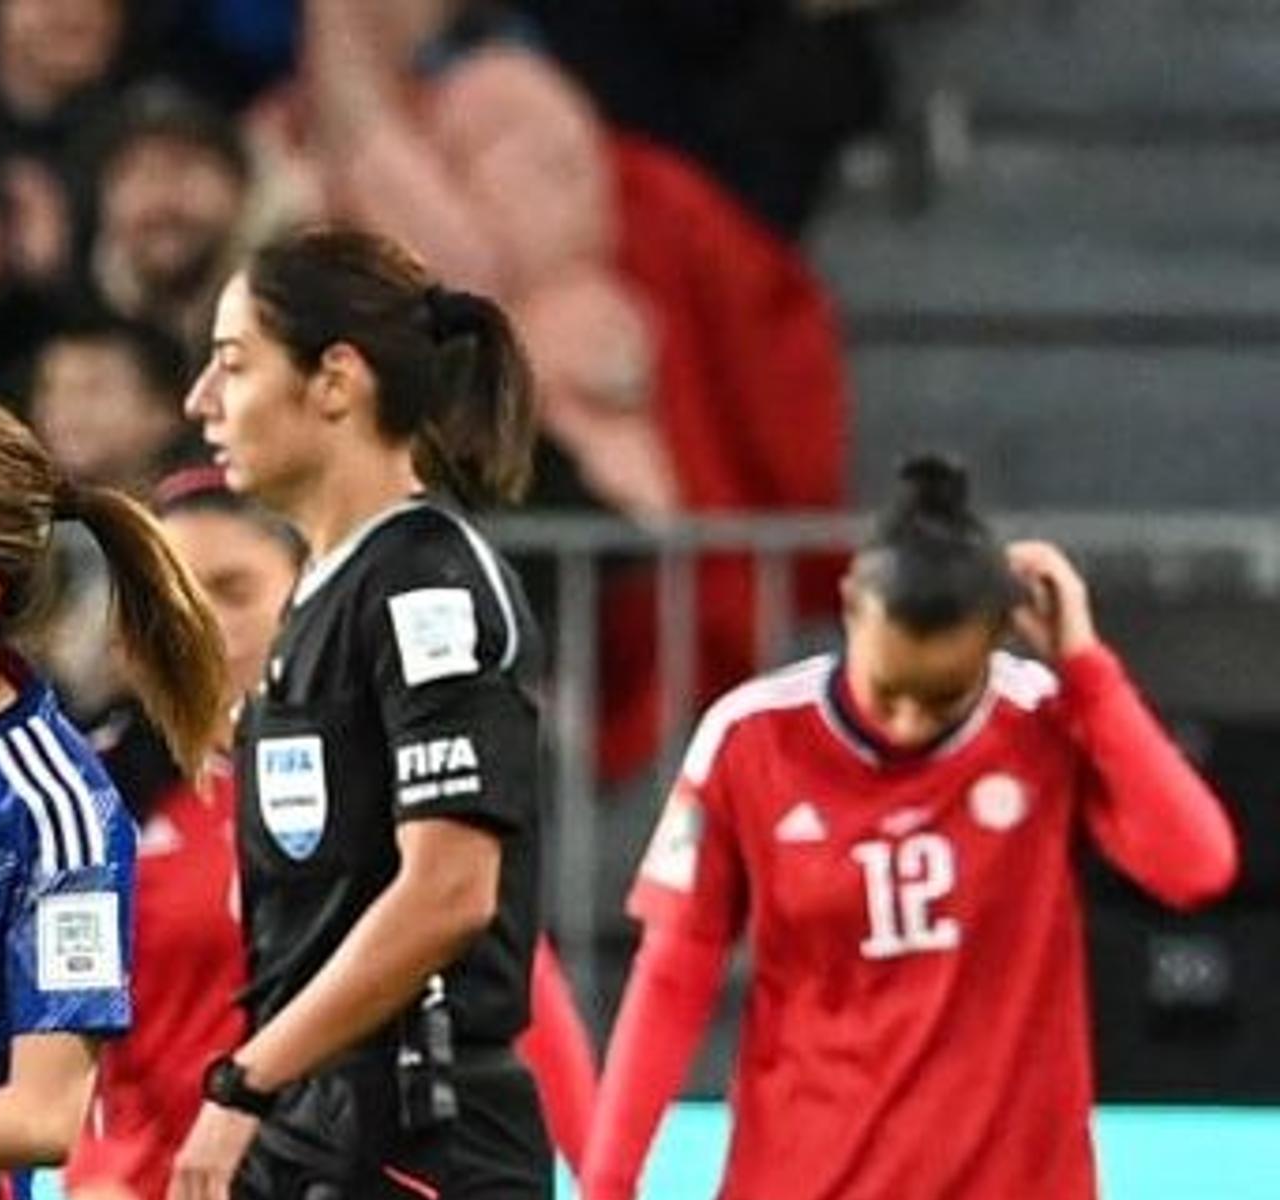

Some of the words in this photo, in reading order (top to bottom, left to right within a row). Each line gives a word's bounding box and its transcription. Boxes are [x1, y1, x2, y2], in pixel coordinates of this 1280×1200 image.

[266, 748, 314, 773] FIFA
[398, 737, 478, 782] FIFA
[850, 833, 960, 959] 12
